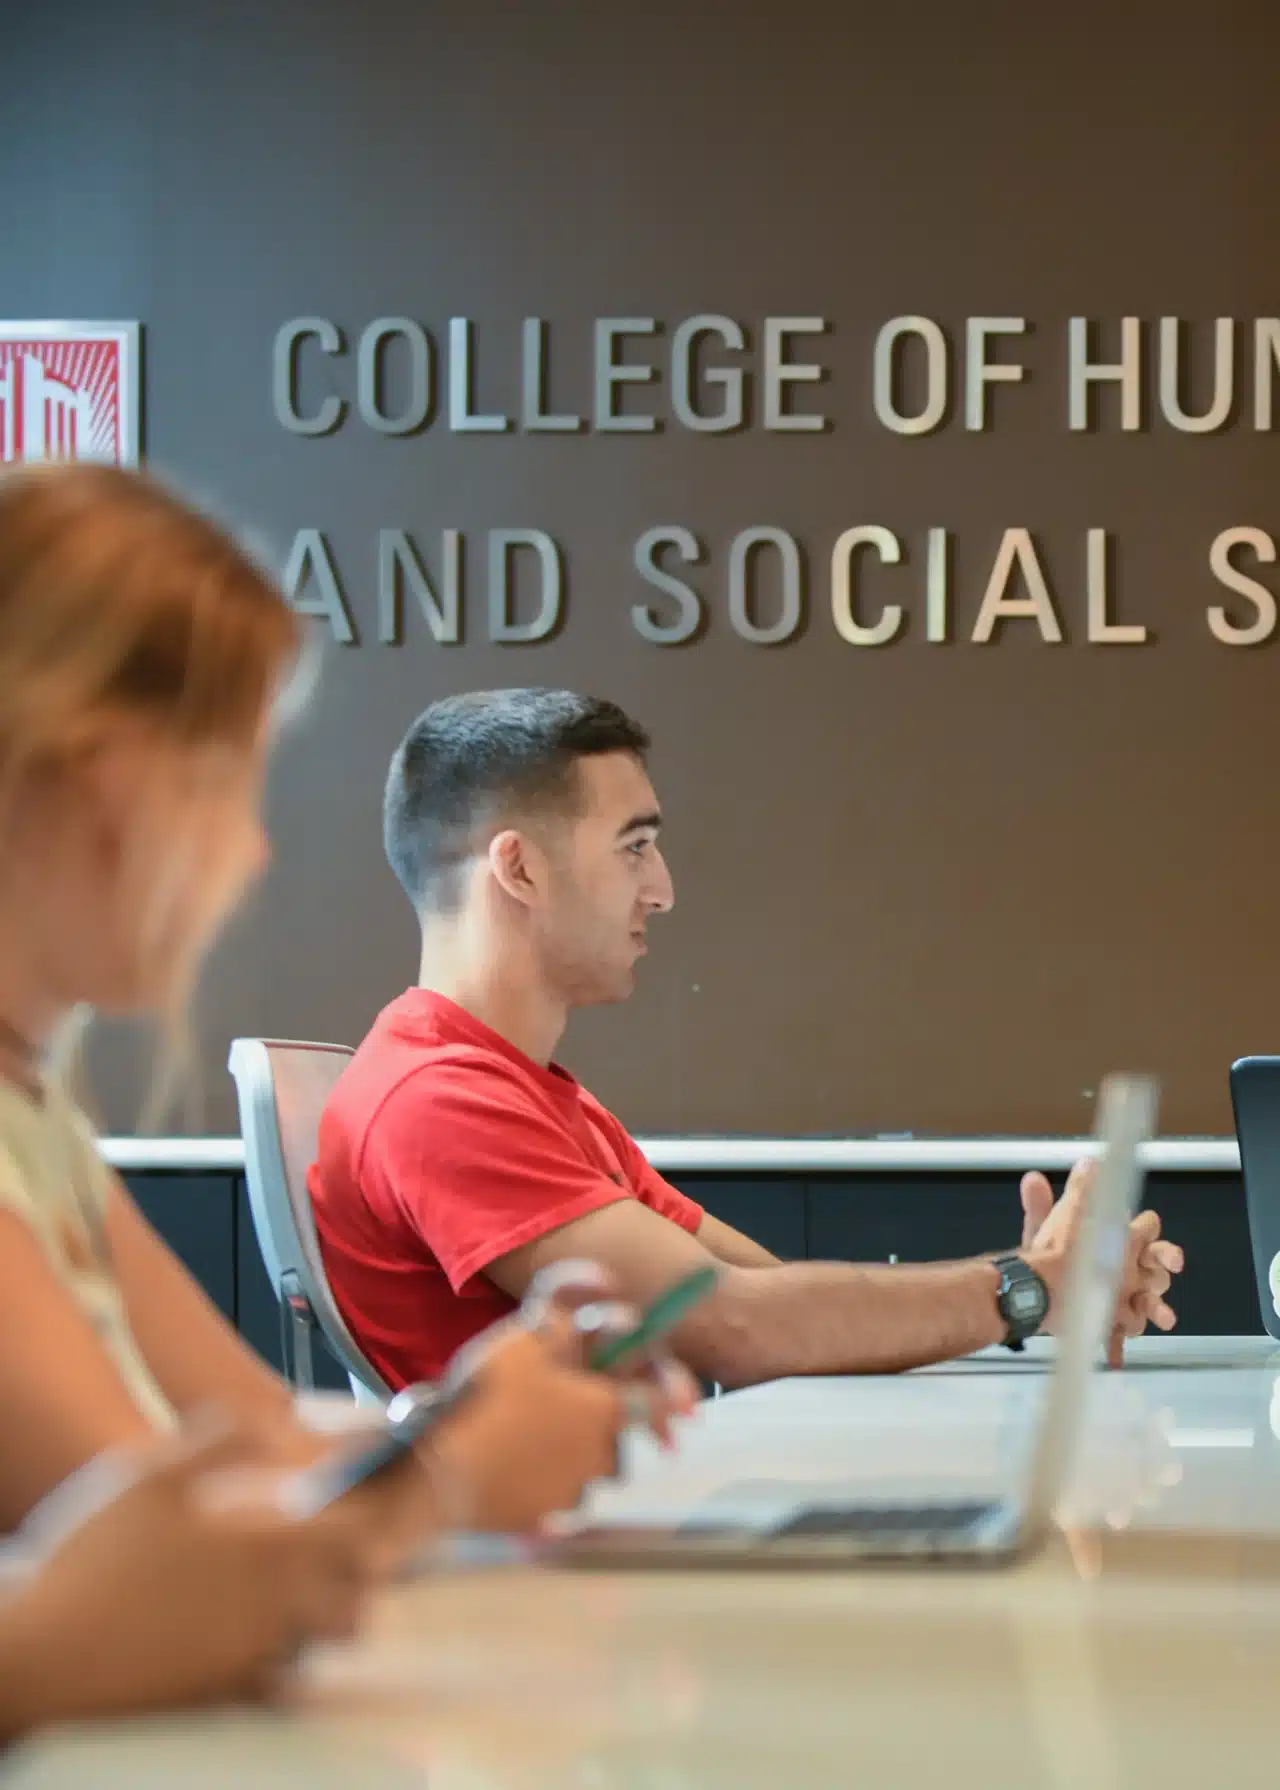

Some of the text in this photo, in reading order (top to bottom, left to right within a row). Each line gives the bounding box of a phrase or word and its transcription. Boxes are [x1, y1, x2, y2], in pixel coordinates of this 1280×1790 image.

[272, 314, 826, 434] COLLEGE
[873, 315, 1026, 434] OF
[284, 527, 564, 644] AND
[631, 525, 1147, 645] SOCIAL
